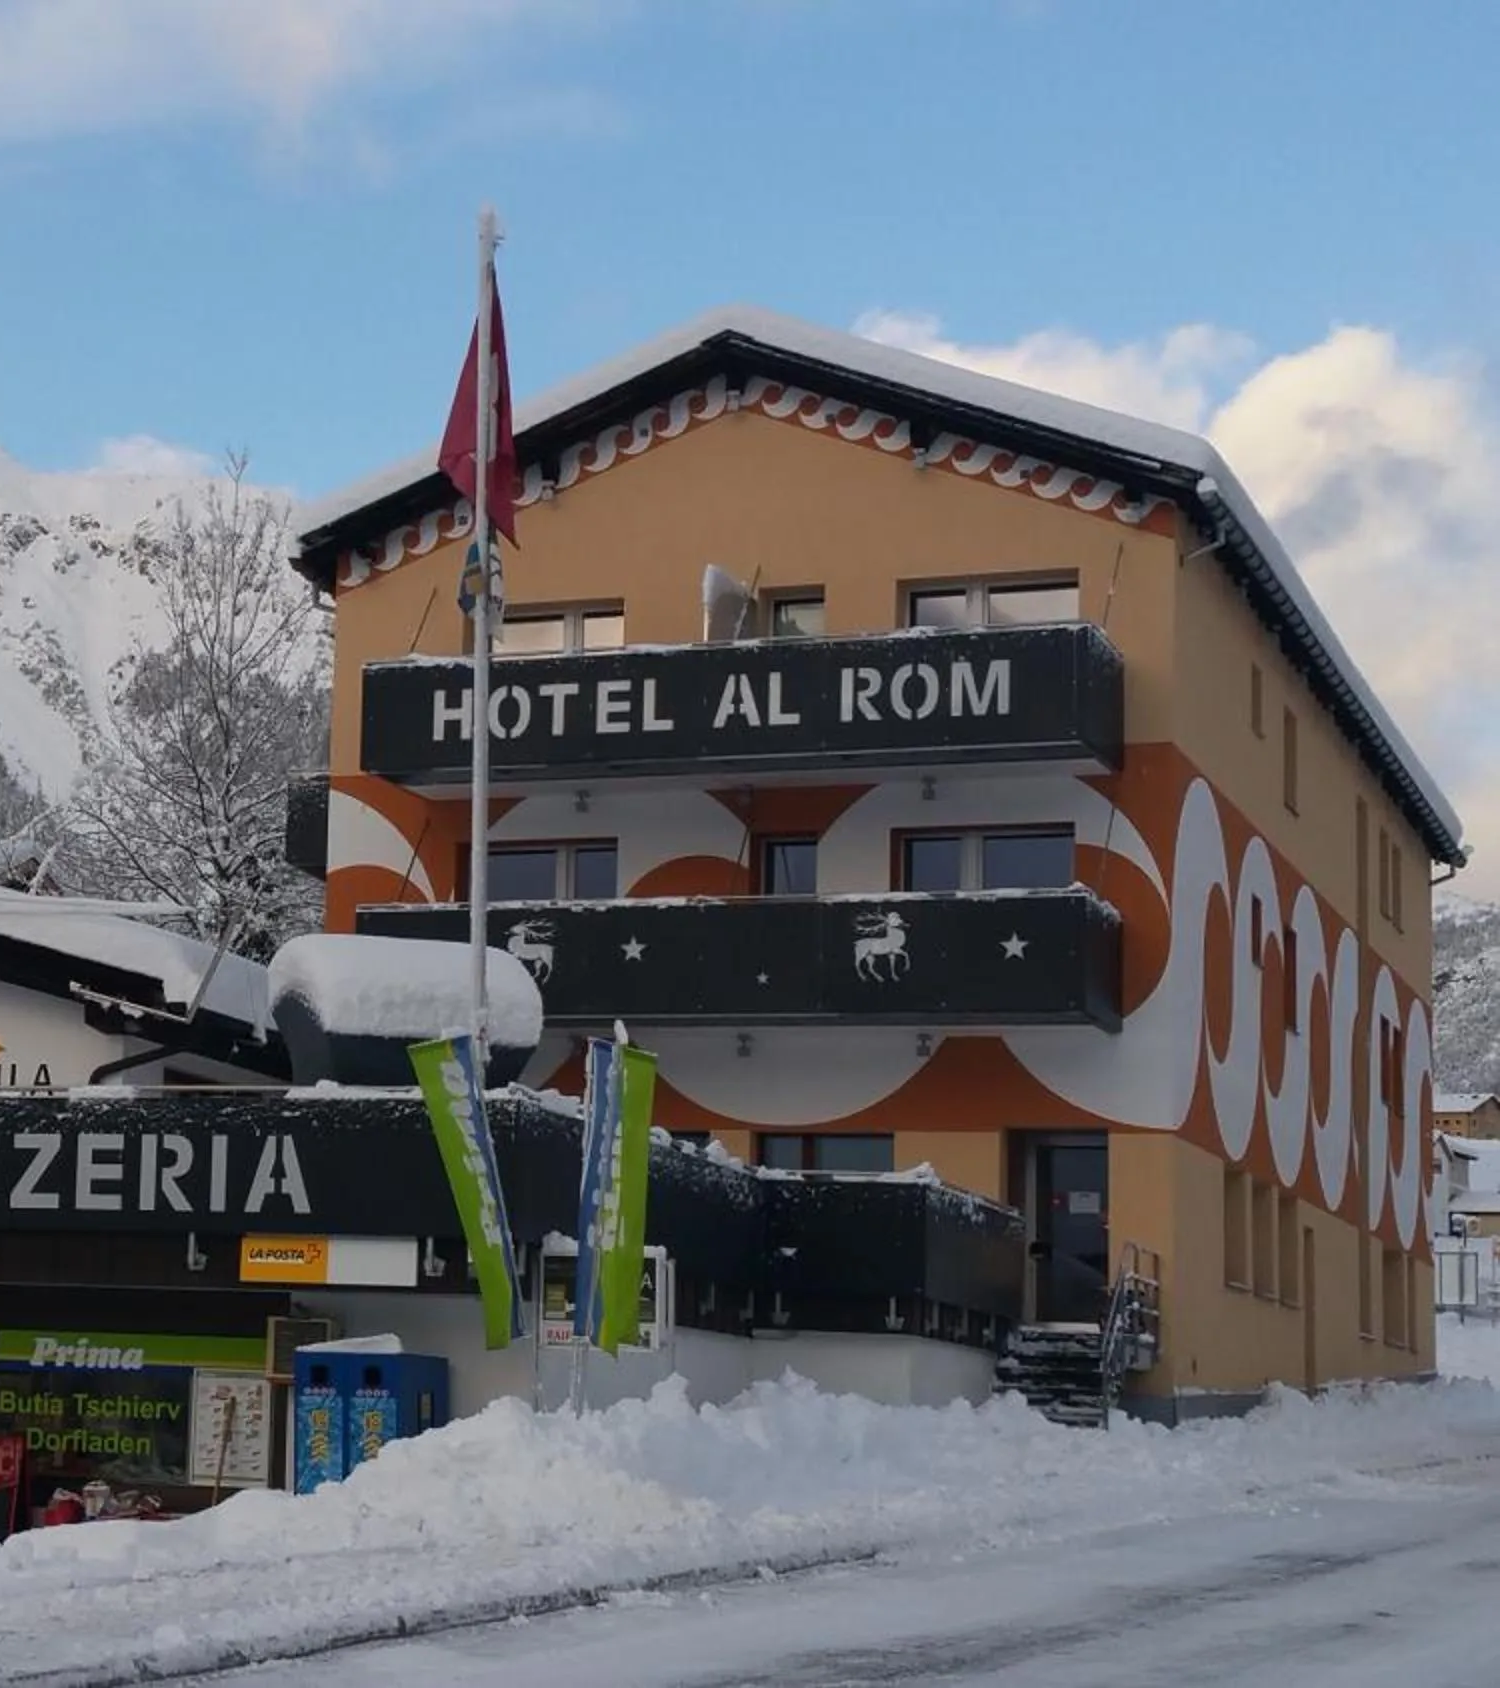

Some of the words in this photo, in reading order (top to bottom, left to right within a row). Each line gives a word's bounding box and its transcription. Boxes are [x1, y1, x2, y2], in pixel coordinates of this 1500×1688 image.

[432, 680, 674, 741] HOTEL
[713, 673, 801, 727] AL
[841, 660, 1011, 721] ROM
[29, 1337, 145, 1370] Prima
[0, 1391, 64, 1414] Butia
[73, 1393, 180, 1421] Tschierv
[26, 1428, 151, 1455] Dorfladen
